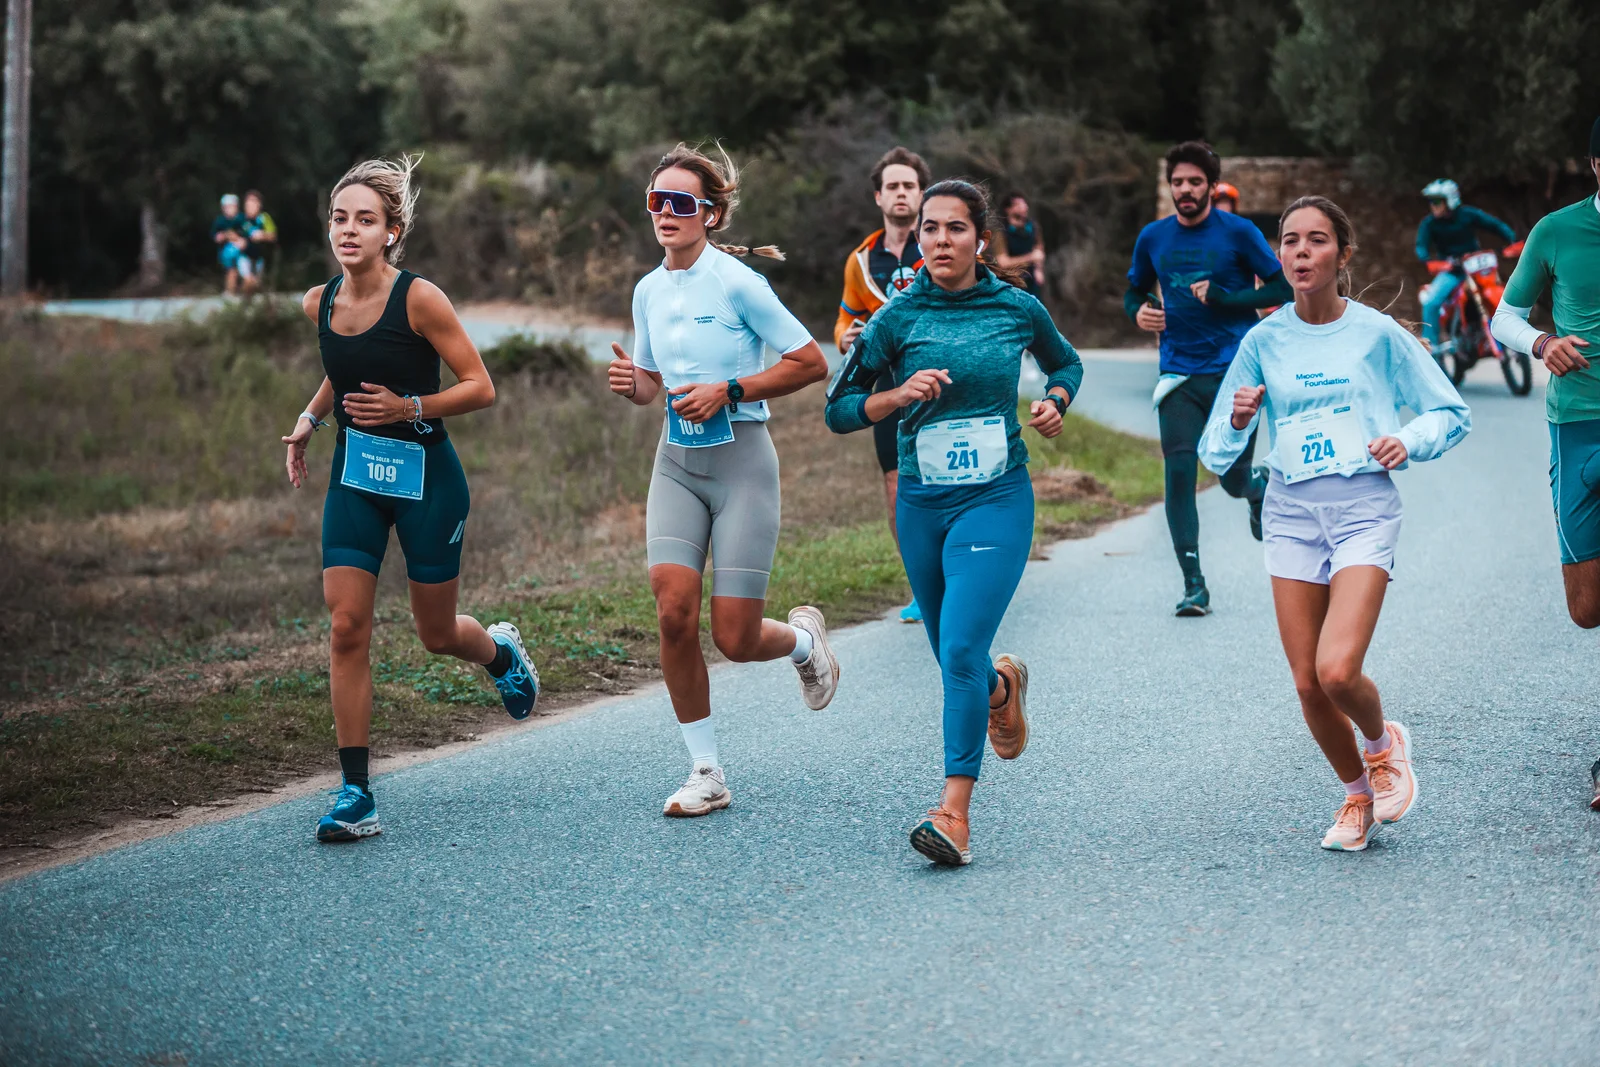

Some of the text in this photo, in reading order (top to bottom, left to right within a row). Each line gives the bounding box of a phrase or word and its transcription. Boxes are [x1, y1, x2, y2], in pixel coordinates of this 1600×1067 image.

[1304, 377, 1350, 387] Foundation
[946, 449, 979, 470] 241
[1301, 438, 1336, 464] 224
[366, 462, 397, 483] 109
